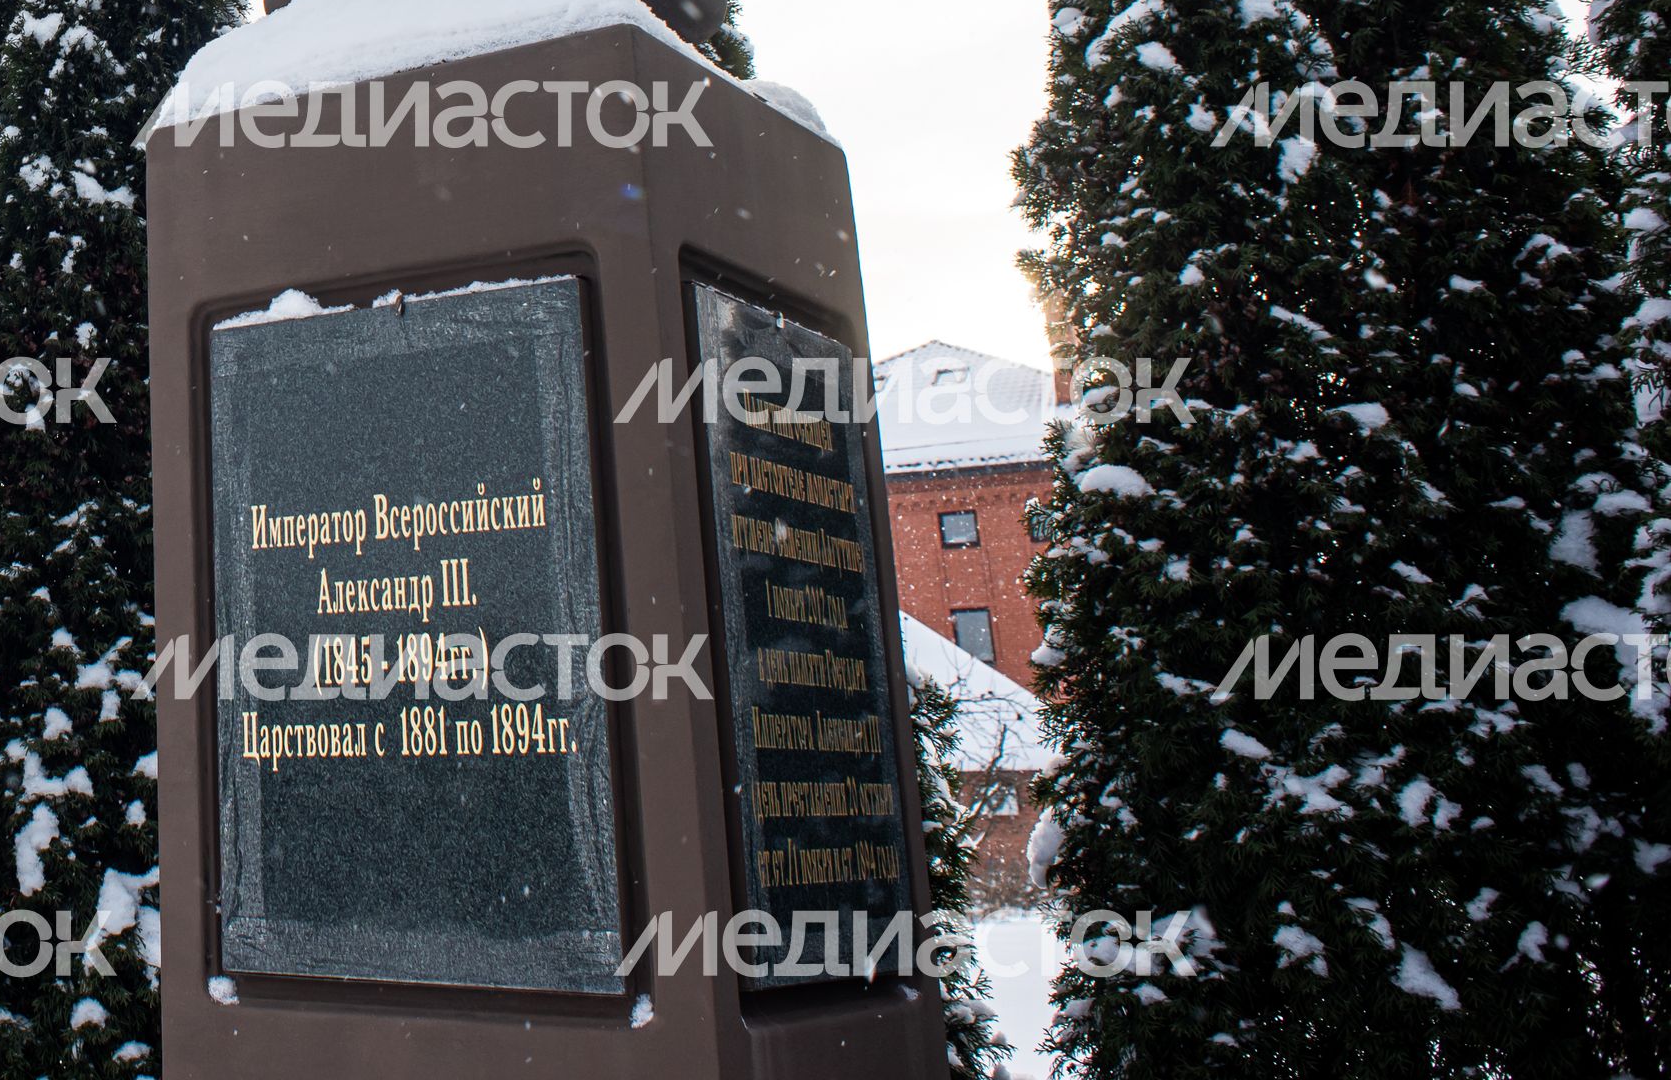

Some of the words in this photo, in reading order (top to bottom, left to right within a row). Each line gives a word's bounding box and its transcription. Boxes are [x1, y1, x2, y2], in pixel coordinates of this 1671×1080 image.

[251, 505, 367, 559] Император
[374, 477, 546, 551] Всероссийский
[317, 568, 434, 622] Александр
[440, 558, 477, 607] III.
[314, 634, 372, 696] (1845
[396, 627, 489, 690] 1894гг.)
[242, 711, 367, 771] Царствовал
[374, 721, 385, 756] с
[400, 705, 448, 756] 1881
[455, 720, 482, 755] по
[490, 703, 578, 755] 1894гг.
